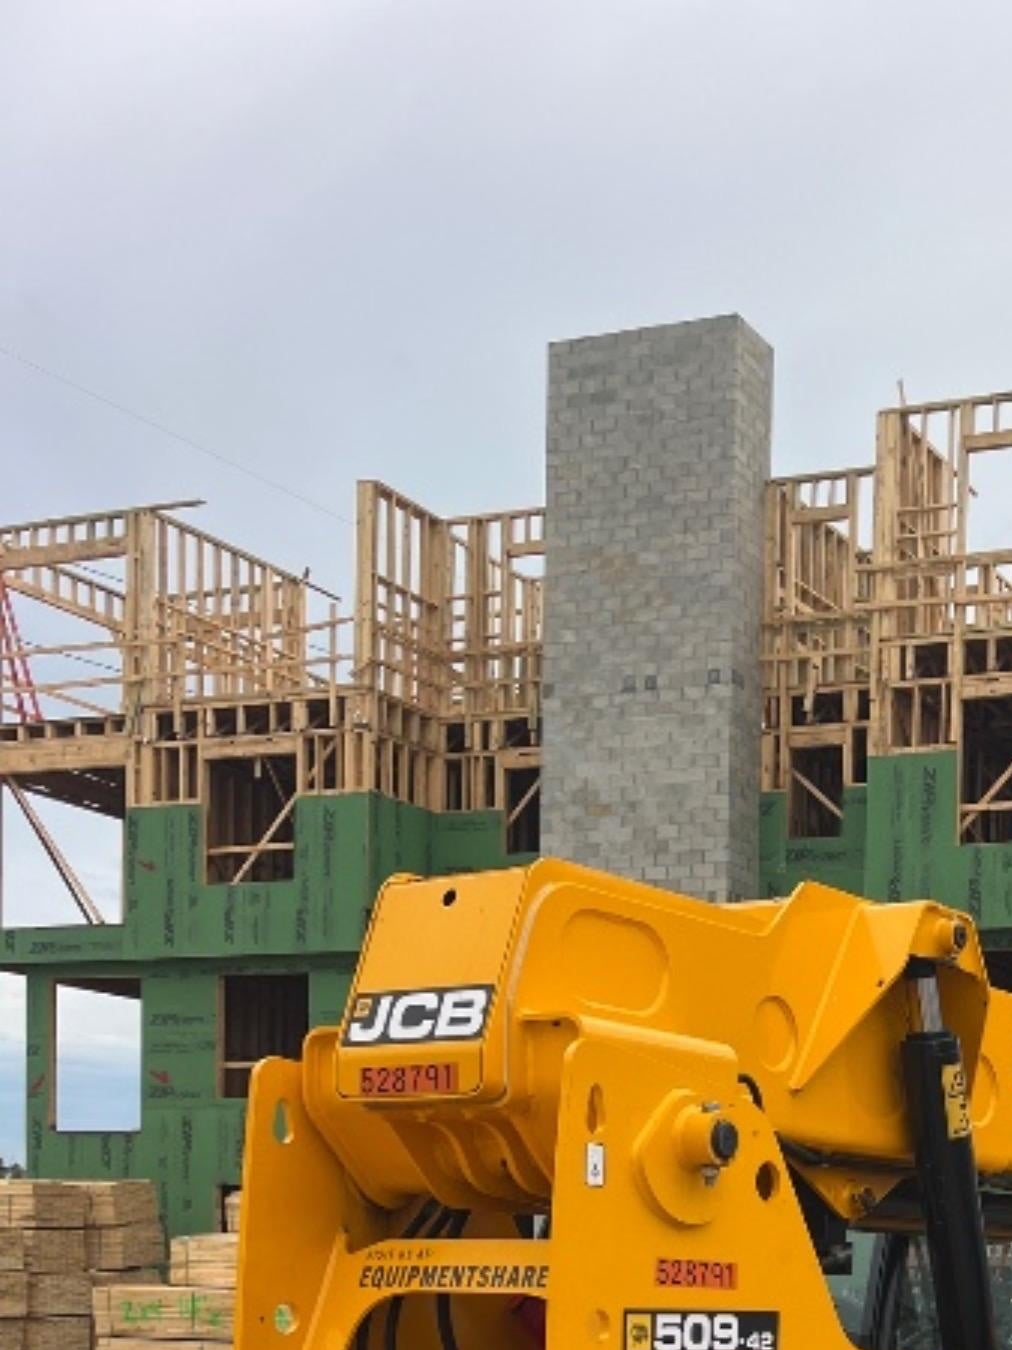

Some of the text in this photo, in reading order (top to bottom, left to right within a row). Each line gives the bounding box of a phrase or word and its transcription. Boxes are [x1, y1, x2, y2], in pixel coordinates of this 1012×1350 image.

[348, 989, 488, 1042] JCB
[360, 1064, 452, 1094] 528791
[359, 1266, 549, 1289] EQUIPMENTSHARE
[657, 1259, 736, 1287] 528791
